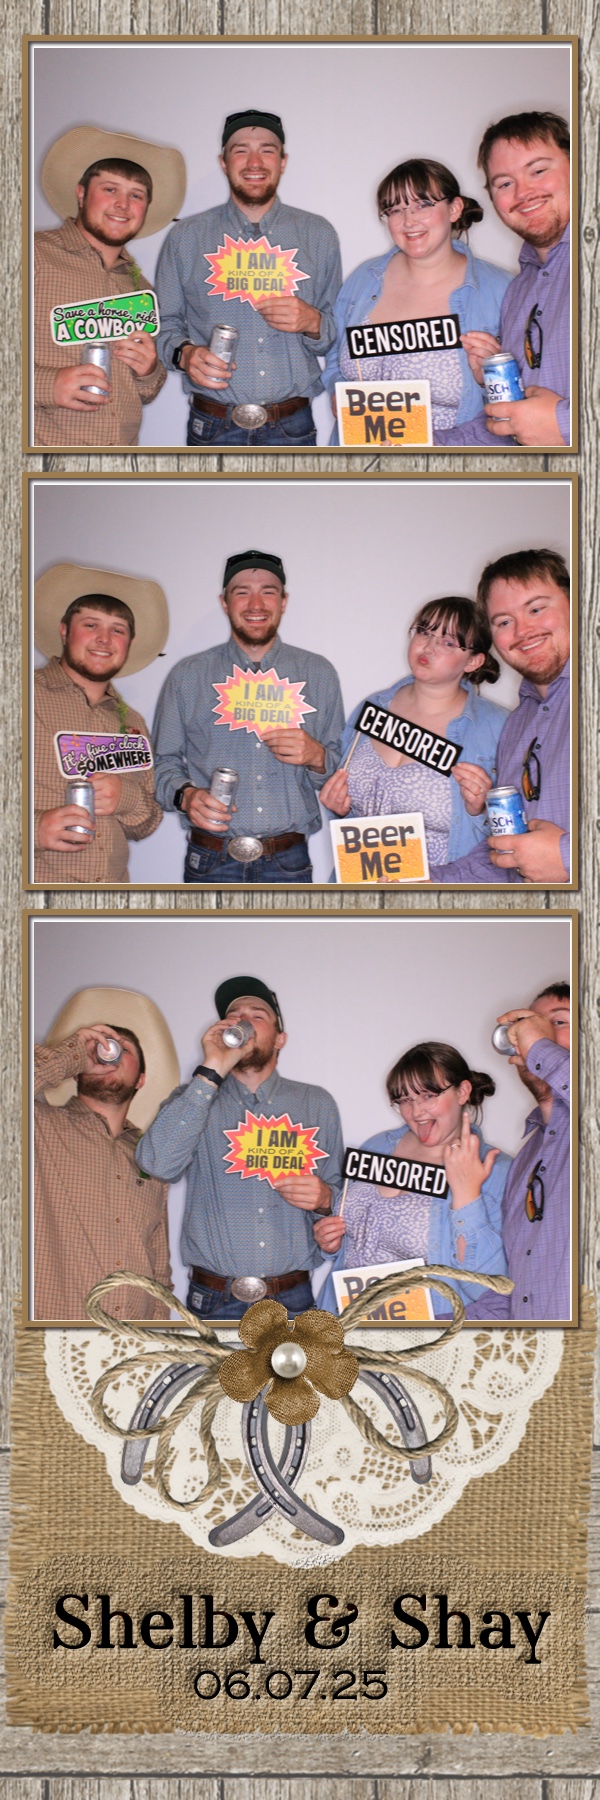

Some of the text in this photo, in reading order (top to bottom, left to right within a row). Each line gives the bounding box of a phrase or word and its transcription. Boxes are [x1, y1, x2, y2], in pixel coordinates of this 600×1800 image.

[236, 253, 277, 270] I AM
[226, 277, 286, 291] BIG DEAL
[53, 301, 157, 324] Save a horse, ride
[56, 317, 146, 341] A COWBOY
[349, 318, 459, 356] CENSORED
[486, 383, 510, 395] SCH
[345, 389, 420, 416] Beer
[364, 415, 405, 443] Me
[244, 683, 284, 702] I AM
[234, 707, 292, 723] BIG DEAL
[86, 742, 108, 760] five
[109, 735, 145, 751] o'clock
[359, 706, 457, 771] CENSORED
[77, 751, 151, 776] SOMEWHERE
[489, 816, 513, 828] SCH
[340, 825, 415, 853] Beer
[360, 851, 402, 880] Me
[256, 1130, 298, 1148] I AM
[245, 1155, 305, 1170] BIG DEAL
[345, 1151, 447, 1195] CENSORED
